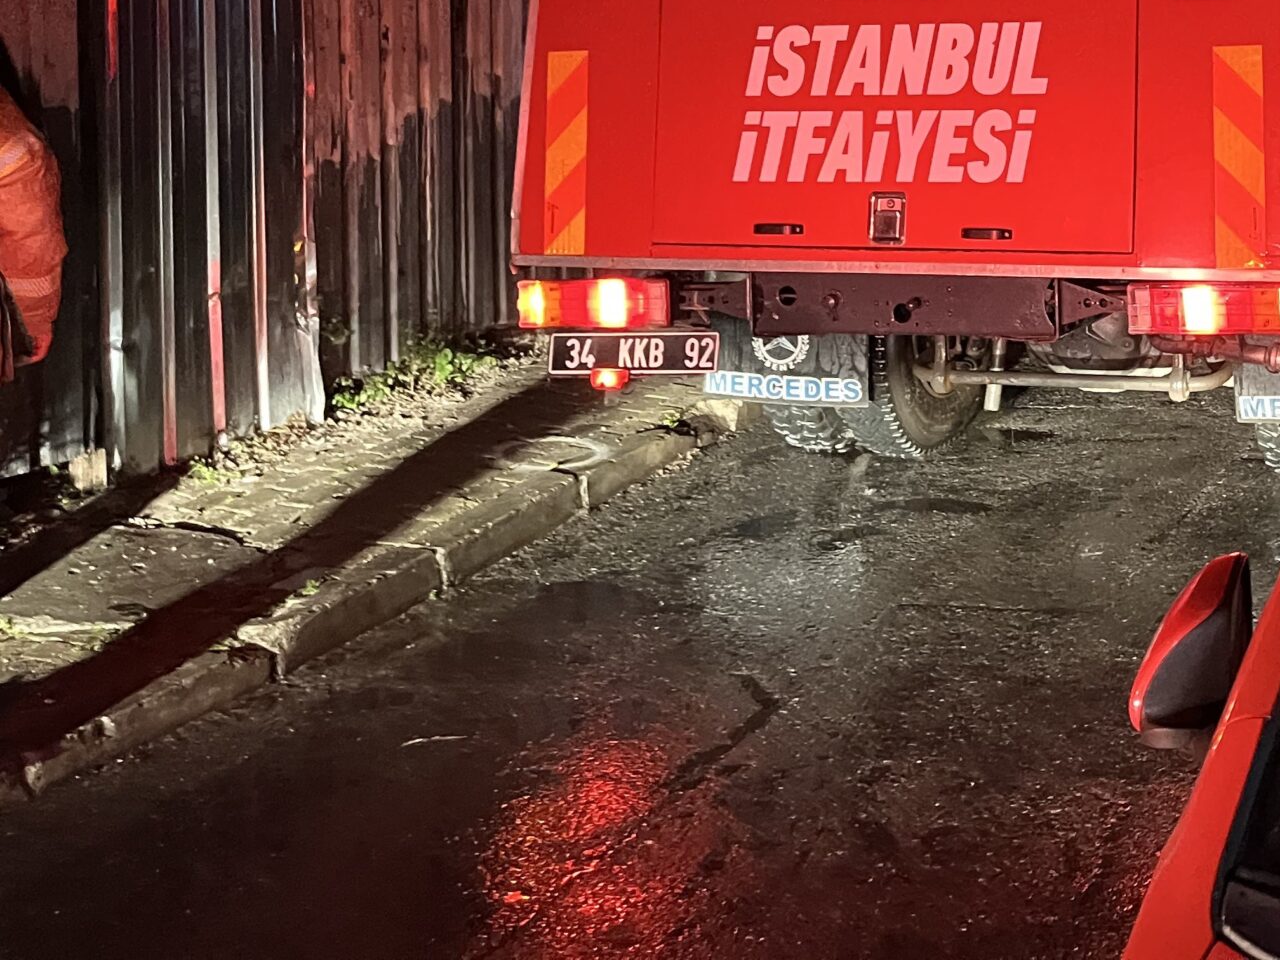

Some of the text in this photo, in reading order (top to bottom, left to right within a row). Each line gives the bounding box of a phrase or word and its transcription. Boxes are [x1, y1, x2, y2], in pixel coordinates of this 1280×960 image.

[745, 21, 1048, 97] İSTANBUL
[732, 109, 1036, 183] İTFAİYESİ
[565, 337, 714, 369] 34 KKB 92
[708, 372, 861, 401] MERCEDES
